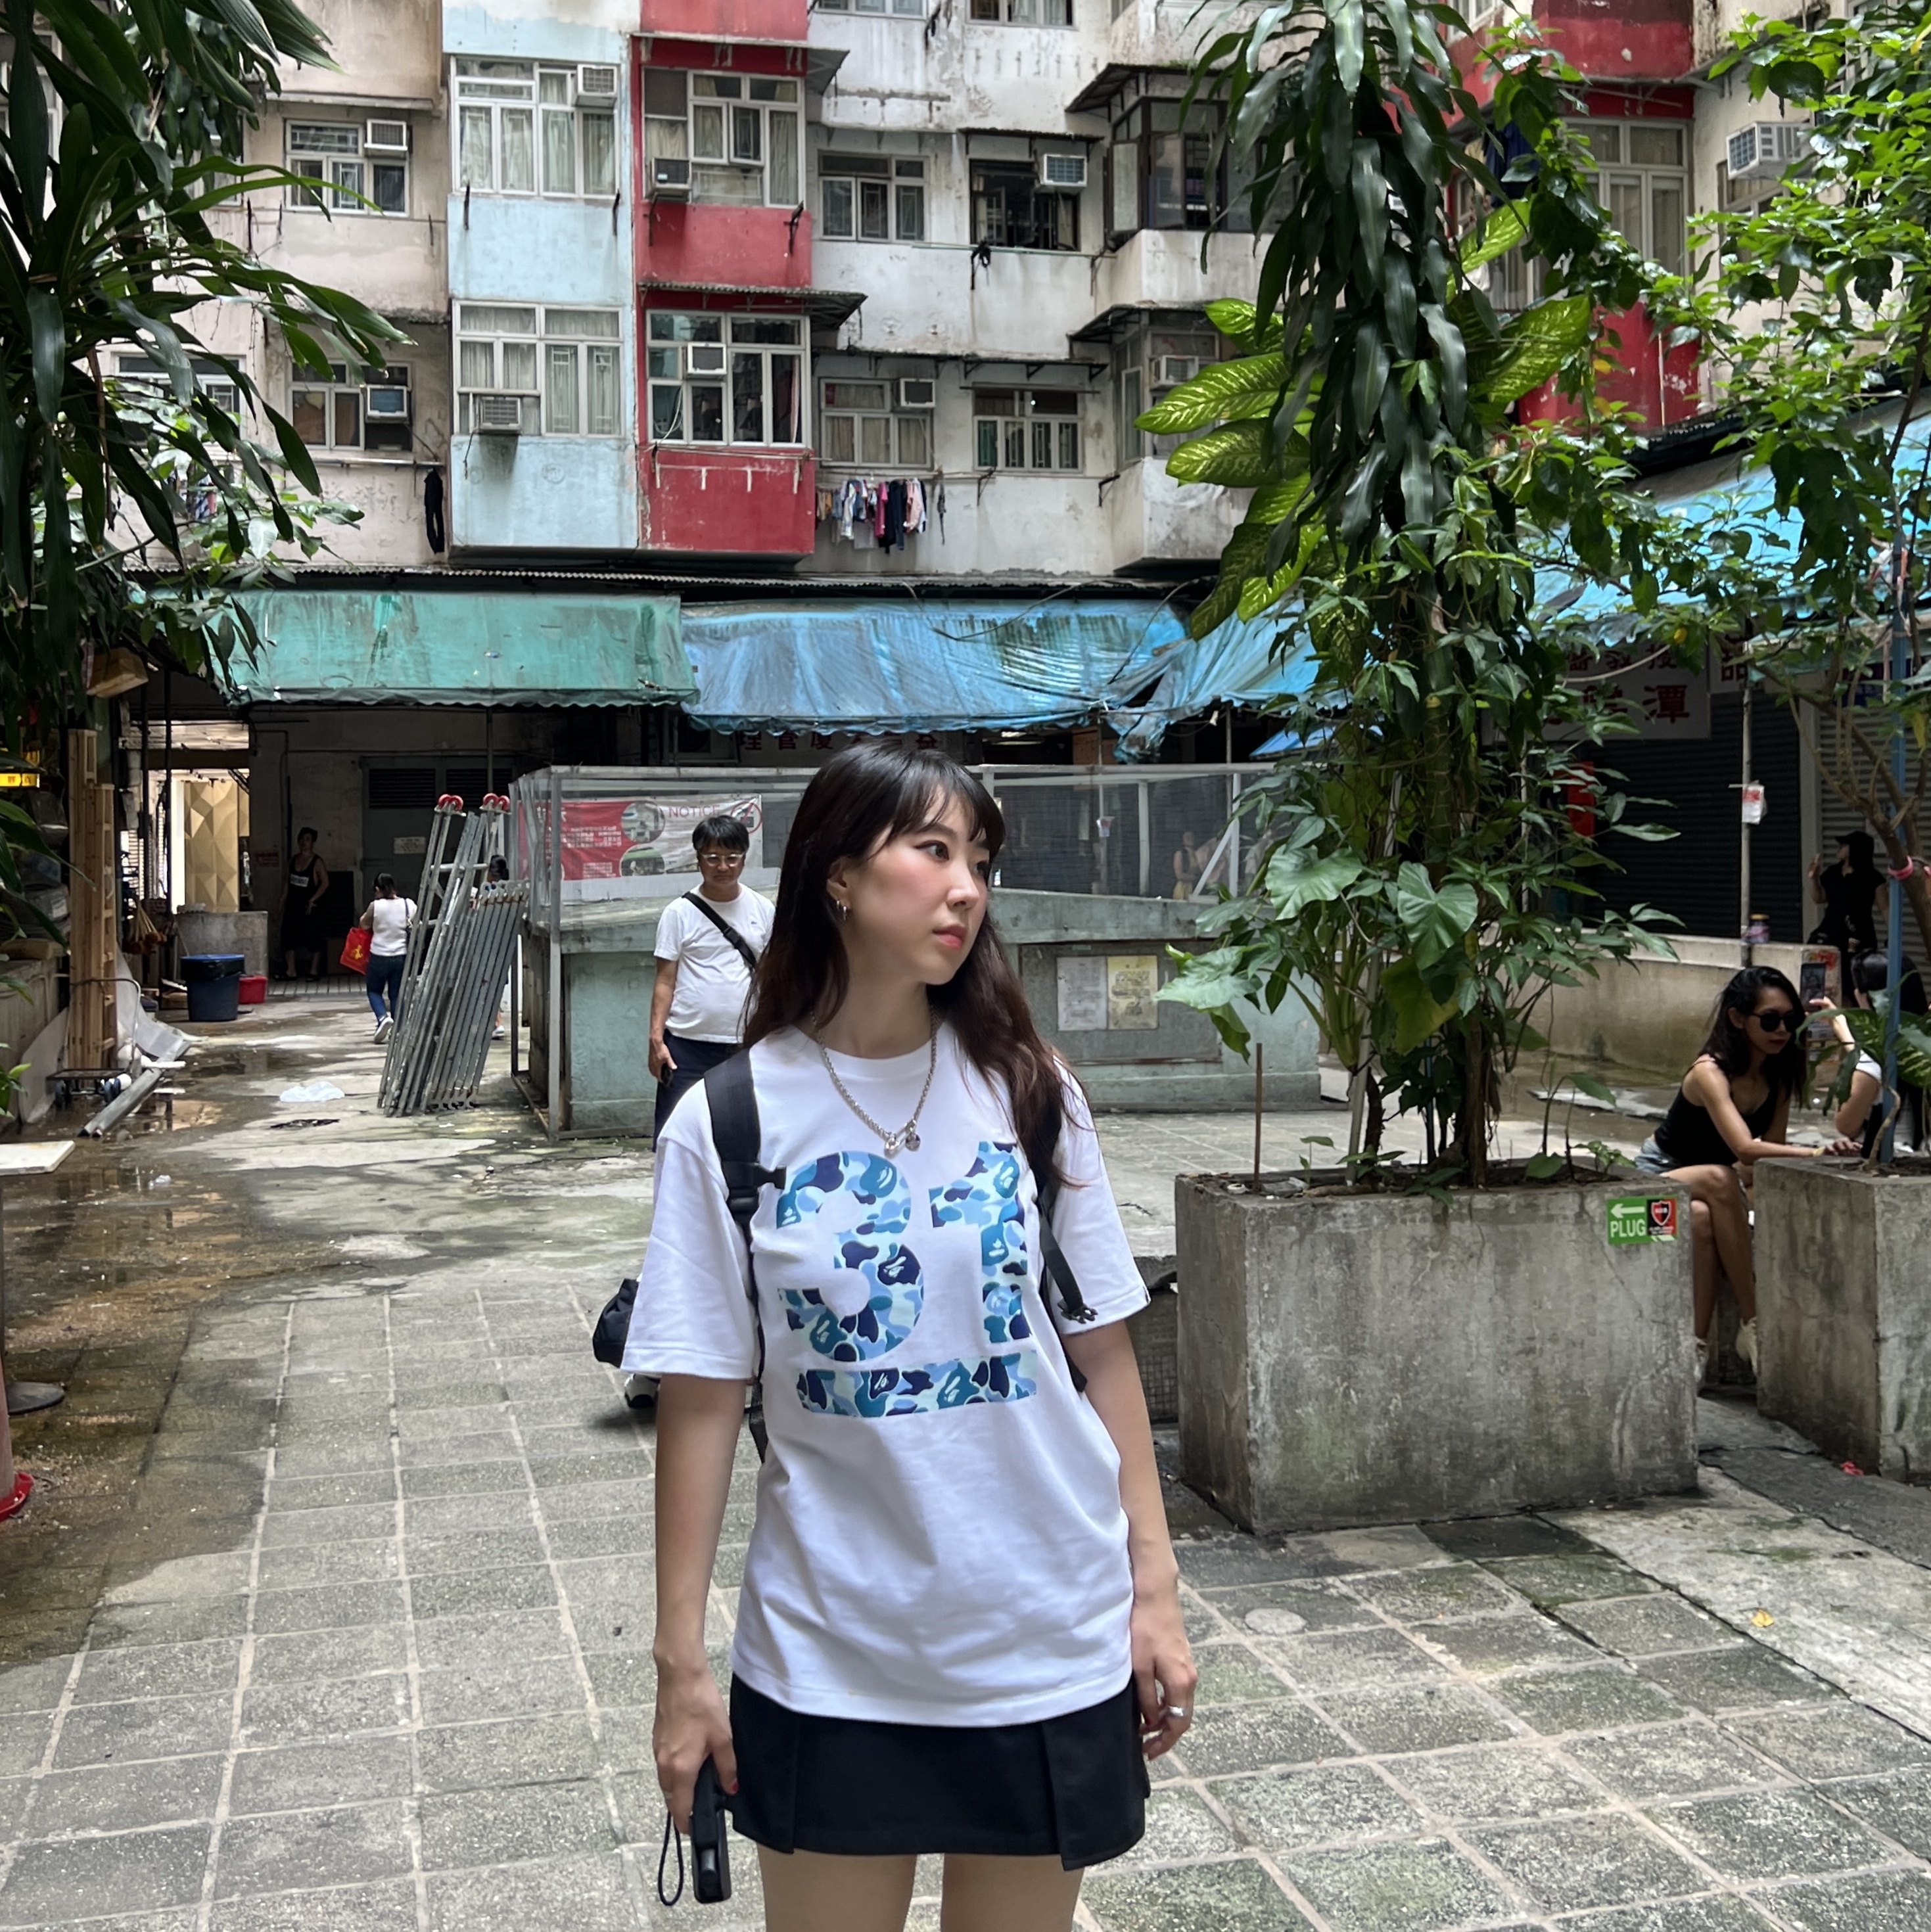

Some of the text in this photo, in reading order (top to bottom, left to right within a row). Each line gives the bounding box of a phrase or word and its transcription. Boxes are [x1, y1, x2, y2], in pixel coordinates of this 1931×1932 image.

[669, 805, 720, 818] NOTICE
[1610, 1219, 1646, 1238] PLUG
[777, 1141, 1033, 1362] 31
